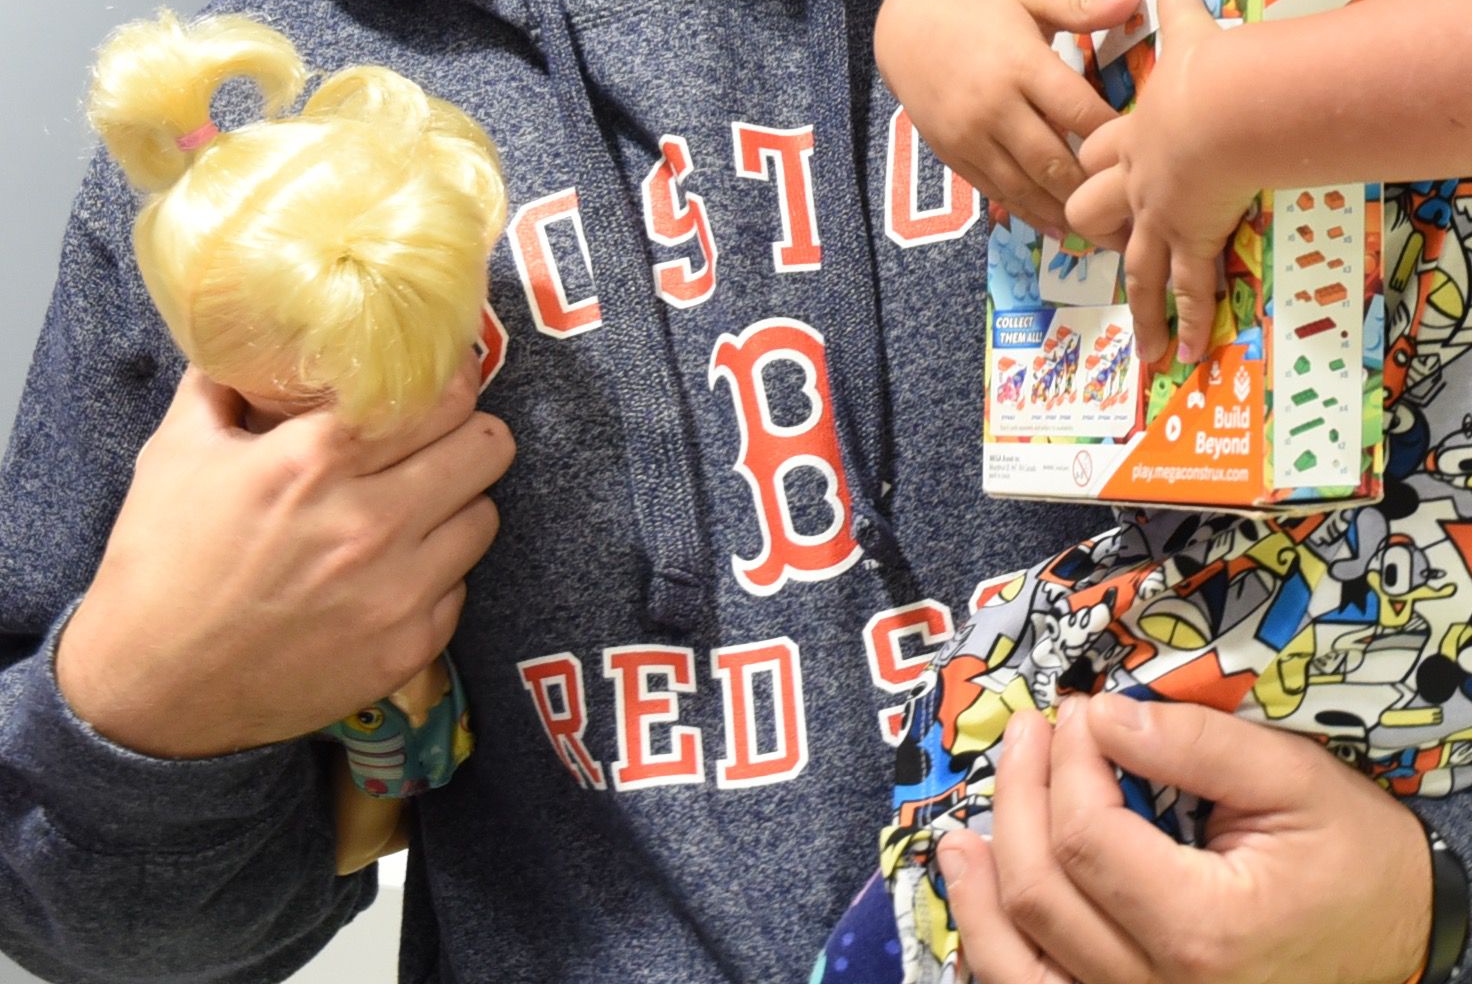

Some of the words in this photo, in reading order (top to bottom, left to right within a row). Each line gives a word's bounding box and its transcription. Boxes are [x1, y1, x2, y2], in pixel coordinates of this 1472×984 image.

[995, 316, 1034, 329] COLLECT
[999, 331, 1027, 344] THEM
[1026, 331, 1043, 343] ALL!
[1214, 404, 1251, 429] Build
[708, 317, 864, 597] B
[1194, 431, 1251, 460] Beyond
[1131, 464, 1250, 484] play.megaconstrux.com
[516, 635, 810, 793] RED
